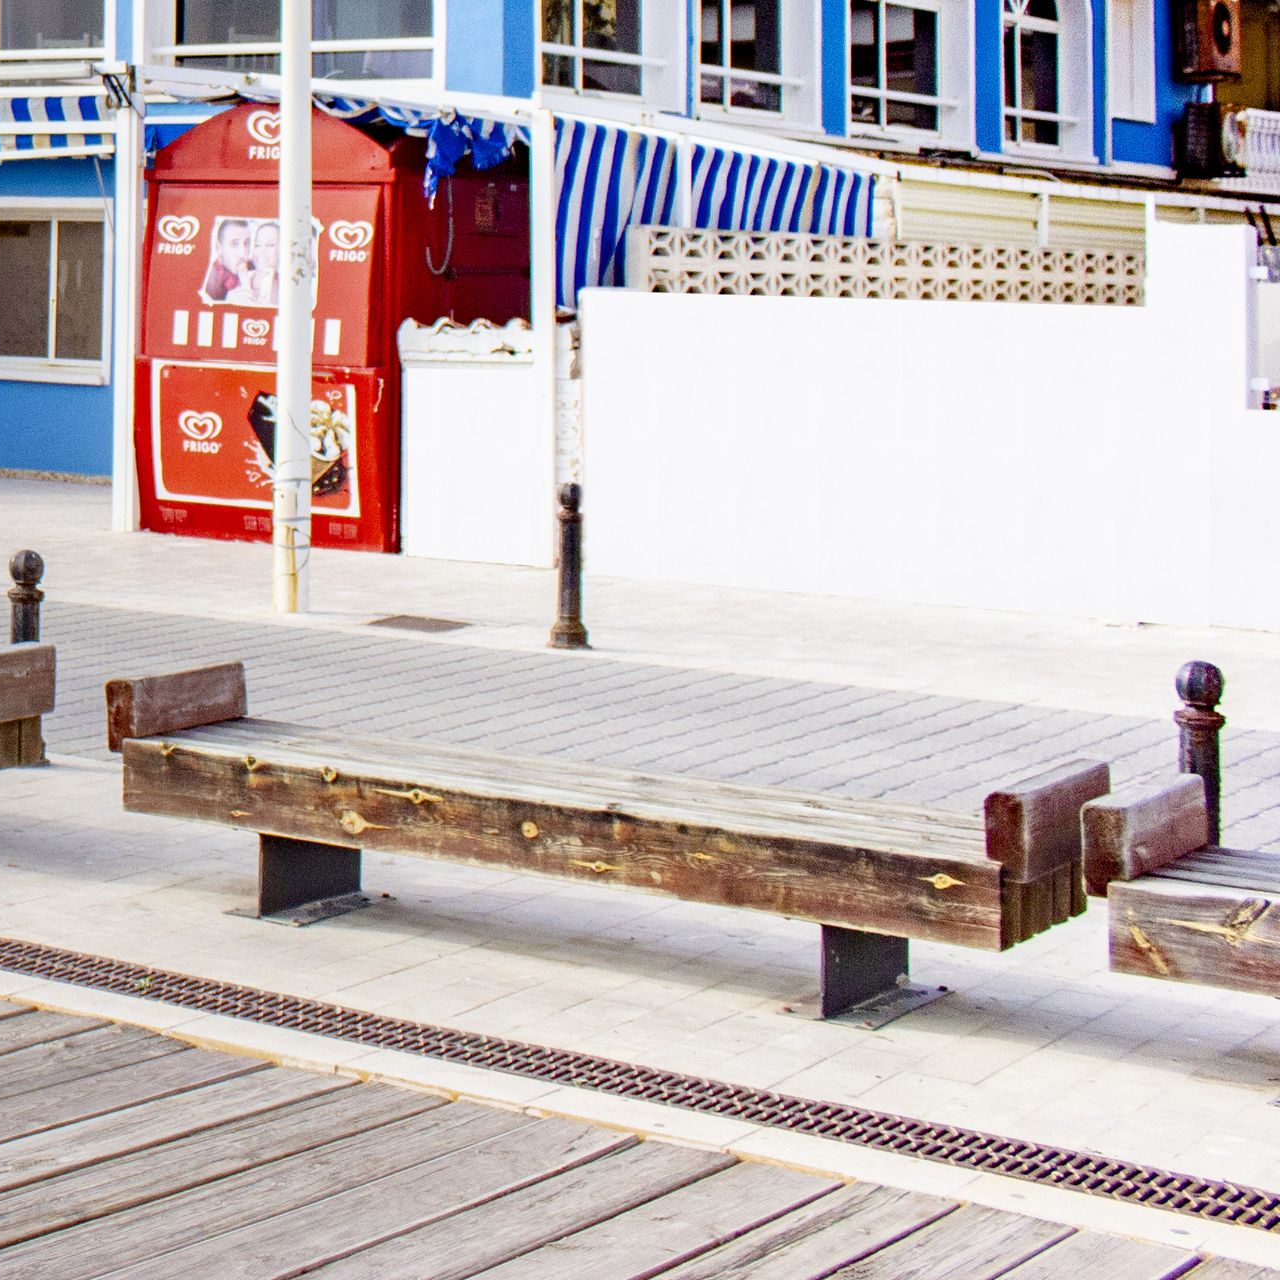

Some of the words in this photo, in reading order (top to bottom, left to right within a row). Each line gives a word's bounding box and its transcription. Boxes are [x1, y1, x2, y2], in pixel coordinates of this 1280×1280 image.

[248, 145, 281, 160] FRIG
[158, 242, 193, 255] FRIGO
[329, 250, 367, 263] FRIGO
[182, 440, 220, 454] FRIGO
